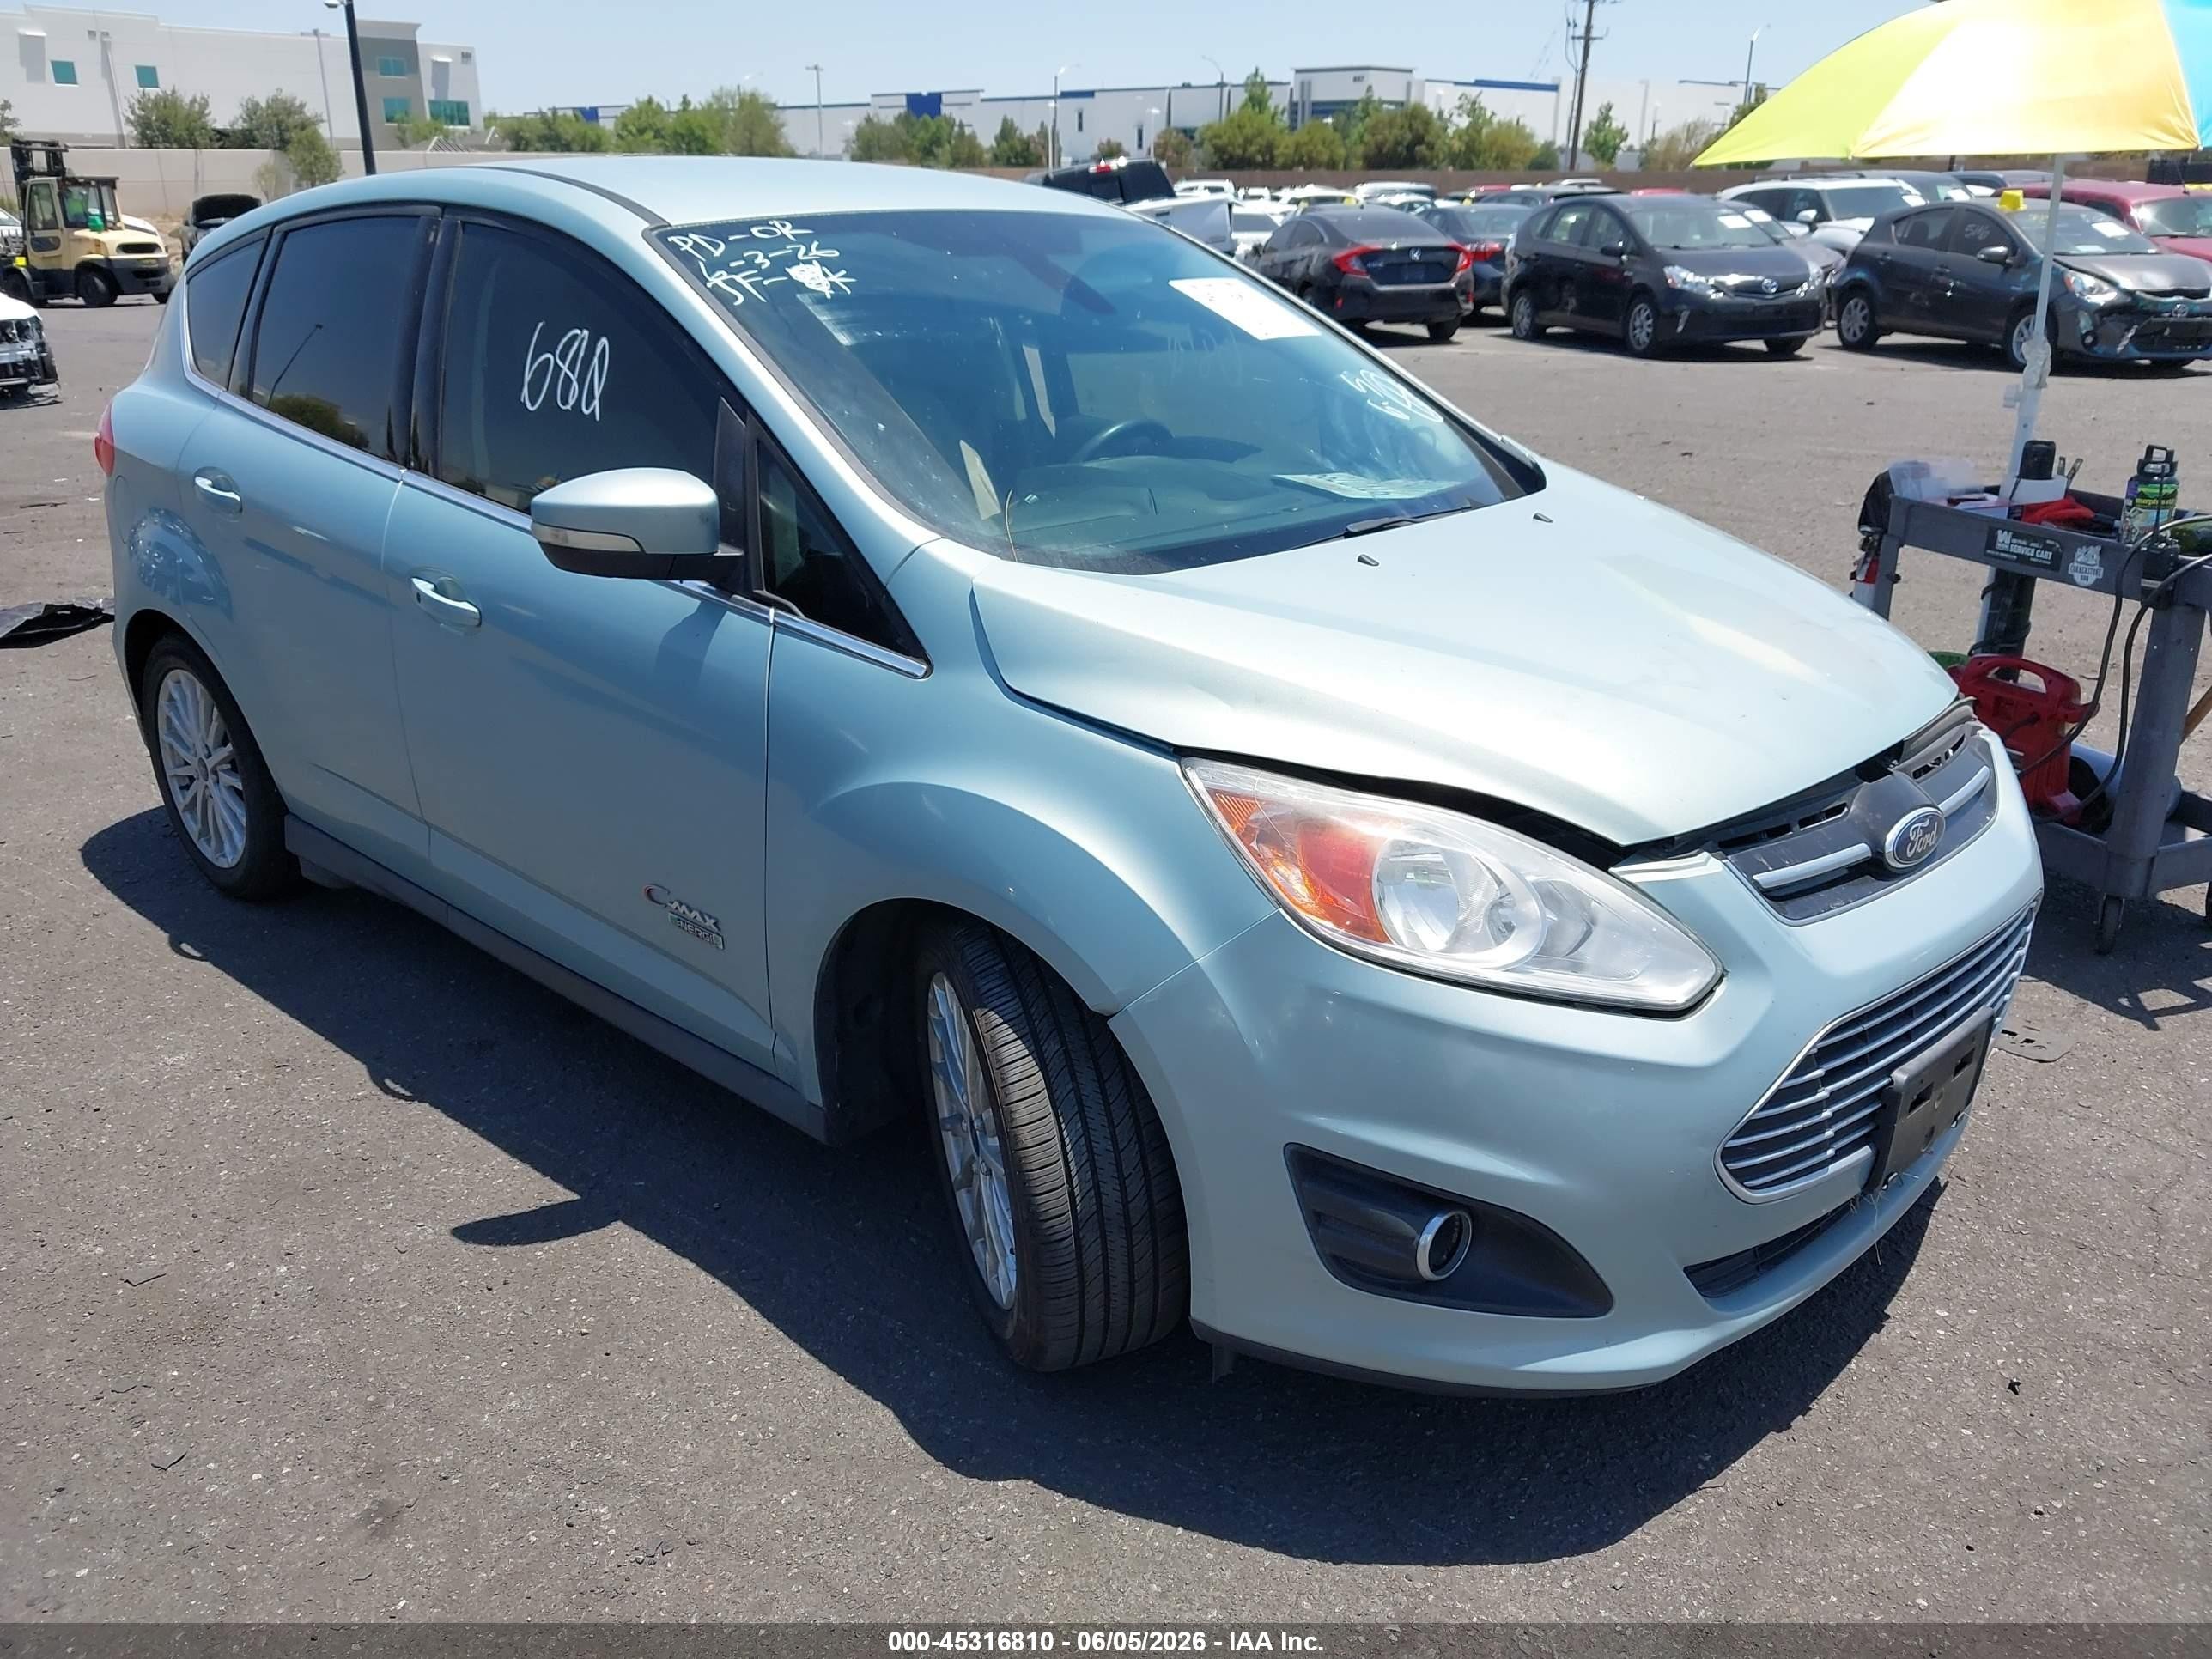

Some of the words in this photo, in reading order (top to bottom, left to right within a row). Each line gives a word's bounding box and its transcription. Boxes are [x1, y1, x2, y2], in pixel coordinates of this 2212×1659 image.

[2009, 544, 2036, 557] SERVICE
[2035, 548, 2053, 560] CART
[1906, 818, 1938, 858] Ford
